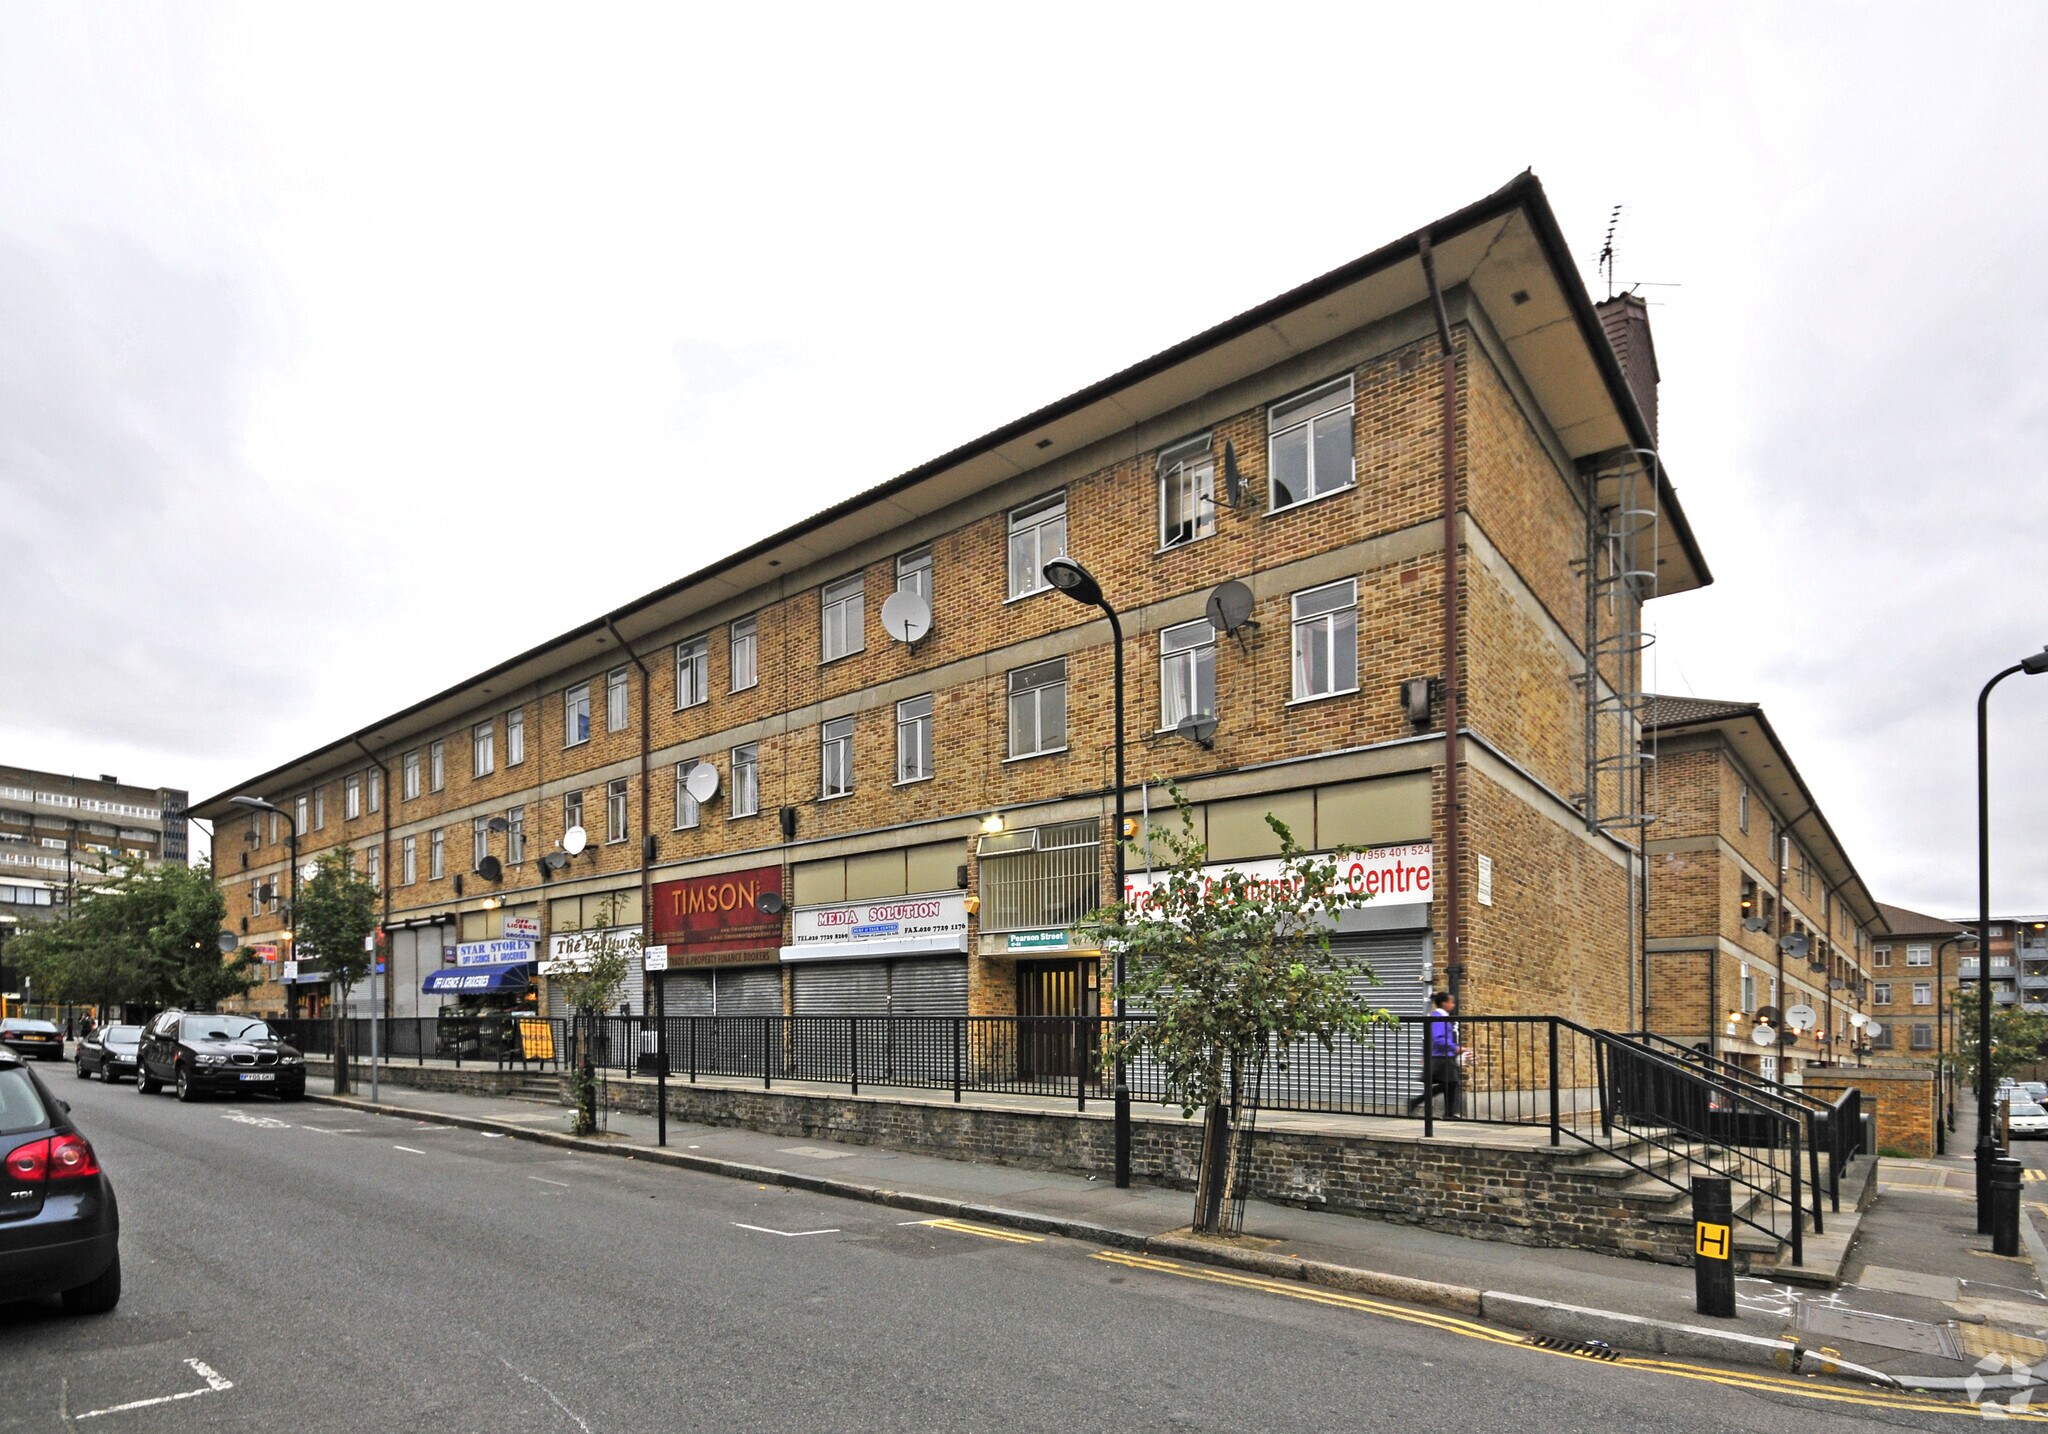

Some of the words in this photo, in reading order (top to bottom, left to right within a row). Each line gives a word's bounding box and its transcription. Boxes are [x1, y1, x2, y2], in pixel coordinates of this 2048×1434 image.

[1356, 849, 1385, 860] 07956
[1389, 847, 1407, 857] 401
[1411, 845, 1430, 855] 524
[1223, 871, 1335, 906] Eterpre
[1348, 860, 1430, 894] Centre
[672, 880, 755, 916] TIMSON
[818, 910, 858, 926] MEDIA
[869, 902, 940, 922] SOLUTION
[1010, 934, 1039, 942] Pearson
[1040, 932, 1063, 940] Street
[460, 944, 484, 955] STAR
[490, 940, 530, 952] STORES
[557, 938, 580, 954] The
[472, 954, 490, 963] LICENCE
[501, 951, 527, 961] GROCERIES
[691, 954, 717, 964] PROPERTY
[718, 952, 741, 963] FINANCE
[743, 951, 769, 962] BROKERS
[441, 977, 460, 988] LICENCE
[464, 975, 490, 987] GROCERIES
[1700, 1226, 1725, 1255] H
